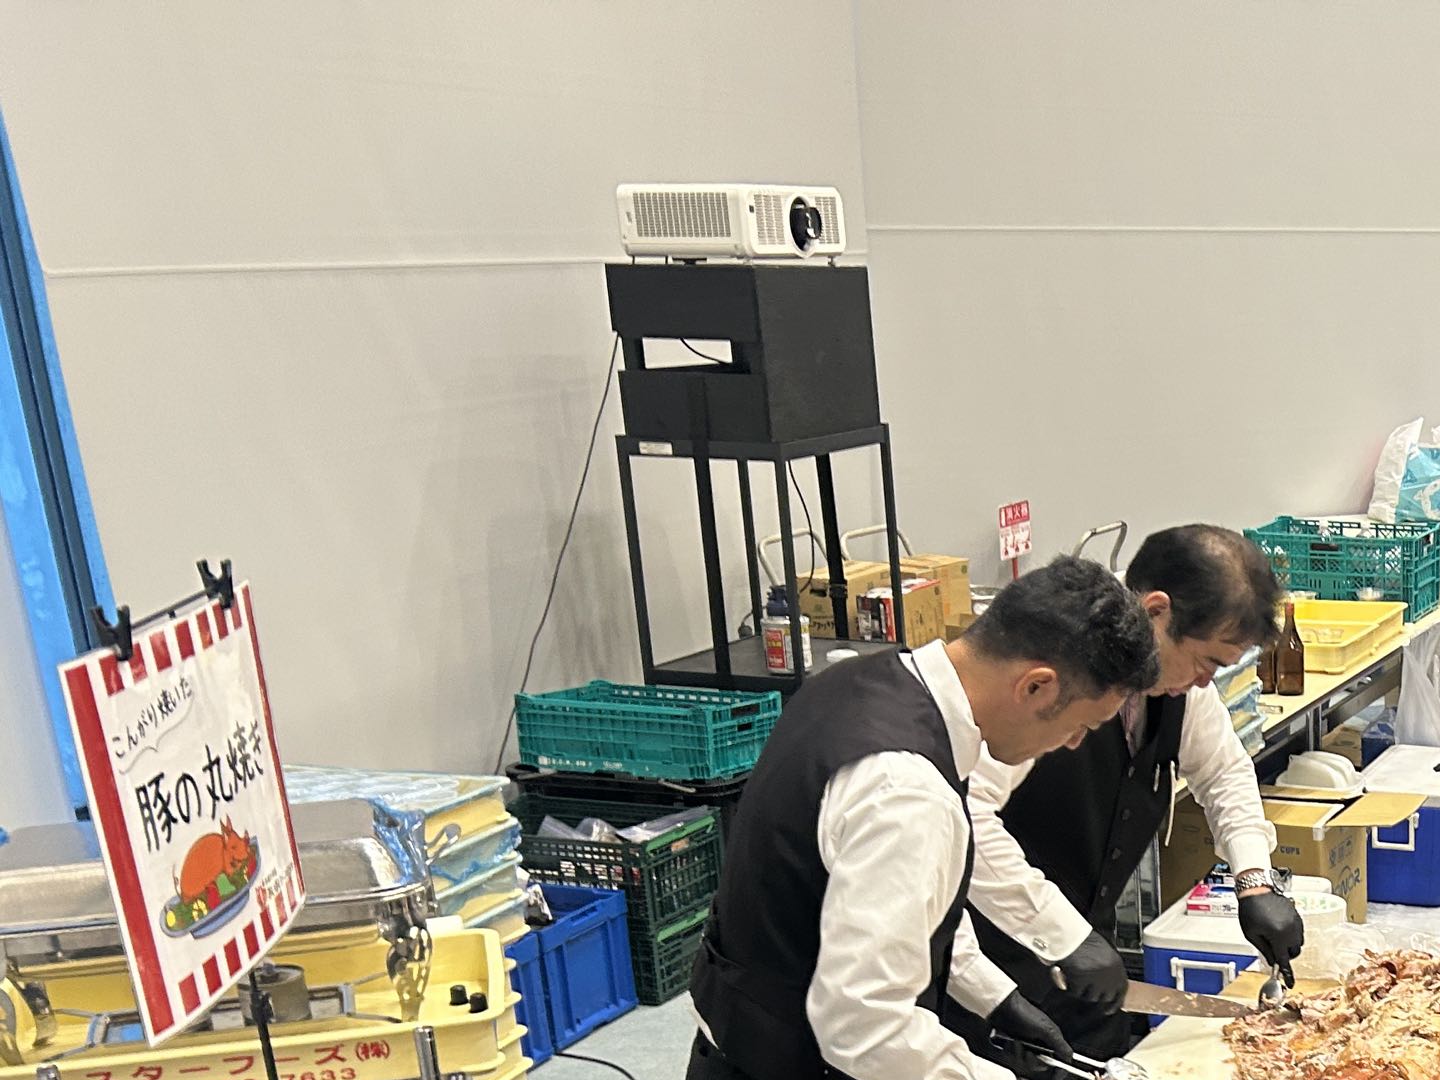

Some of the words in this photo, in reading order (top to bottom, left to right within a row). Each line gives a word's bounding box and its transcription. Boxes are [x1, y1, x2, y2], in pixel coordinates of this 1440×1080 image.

[113, 677, 193, 759] こんがり焼いた
[135, 719, 264, 853] 豚の丸焼き
